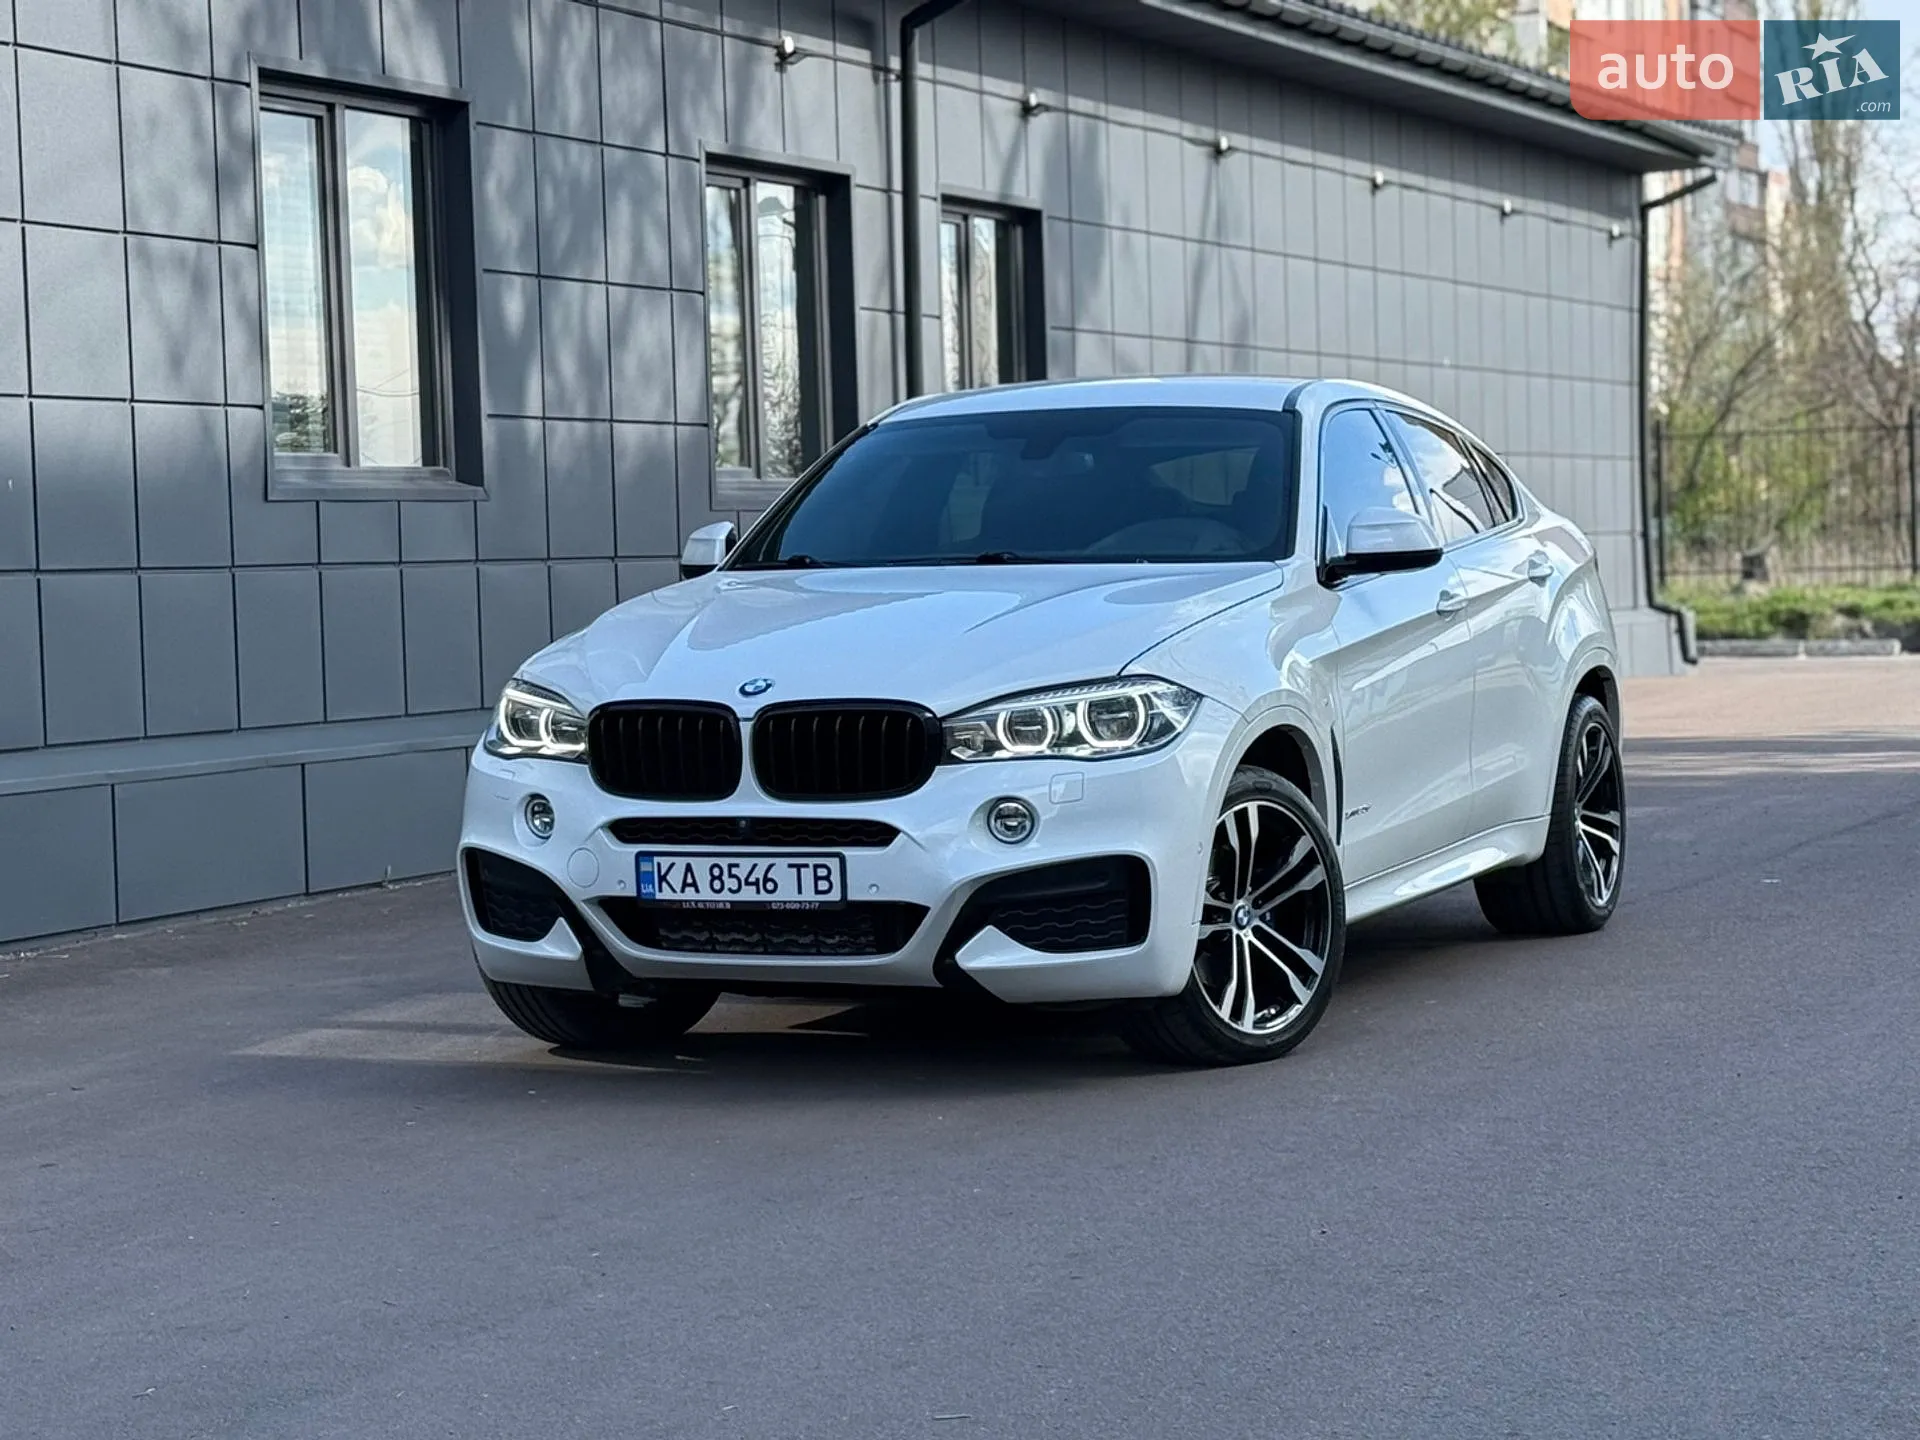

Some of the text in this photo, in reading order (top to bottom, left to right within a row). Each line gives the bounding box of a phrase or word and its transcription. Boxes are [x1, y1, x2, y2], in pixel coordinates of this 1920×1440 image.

[657, 861, 833, 895] KA 8546 TB
